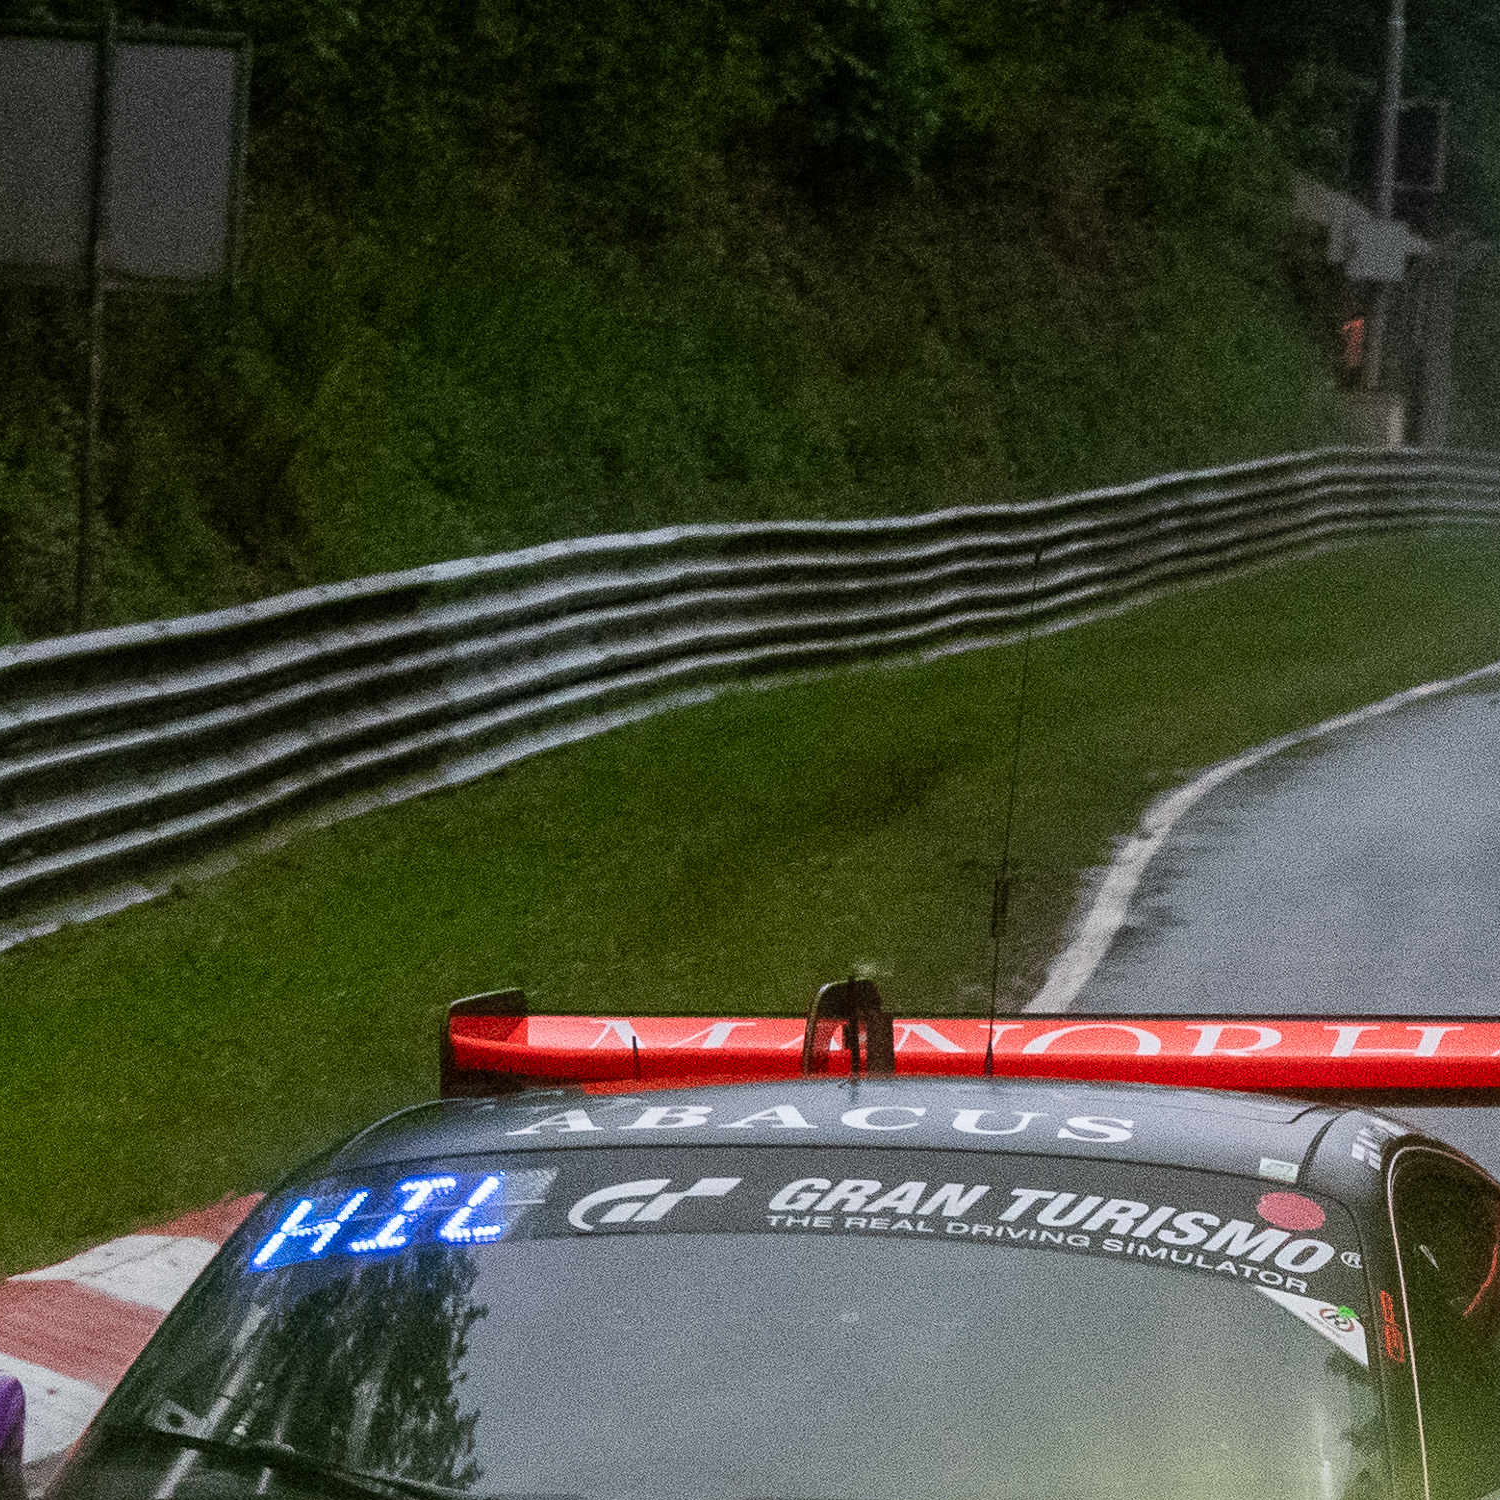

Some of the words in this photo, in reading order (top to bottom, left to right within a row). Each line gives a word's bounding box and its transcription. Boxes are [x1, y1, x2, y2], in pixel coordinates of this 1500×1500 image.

[505, 1104, 1136, 1144] ABACUS
[251, 1170, 507, 1270] HIL
[767, 1178, 991, 1218] GRAN
[999, 1188, 1335, 1274] TURISMO
[767, 1217, 834, 1229] THE
[845, 1218, 937, 1234] REAL
[946, 1222, 1092, 1249] DRIVING
[1102, 1237, 1309, 1293] SIMULATOR
